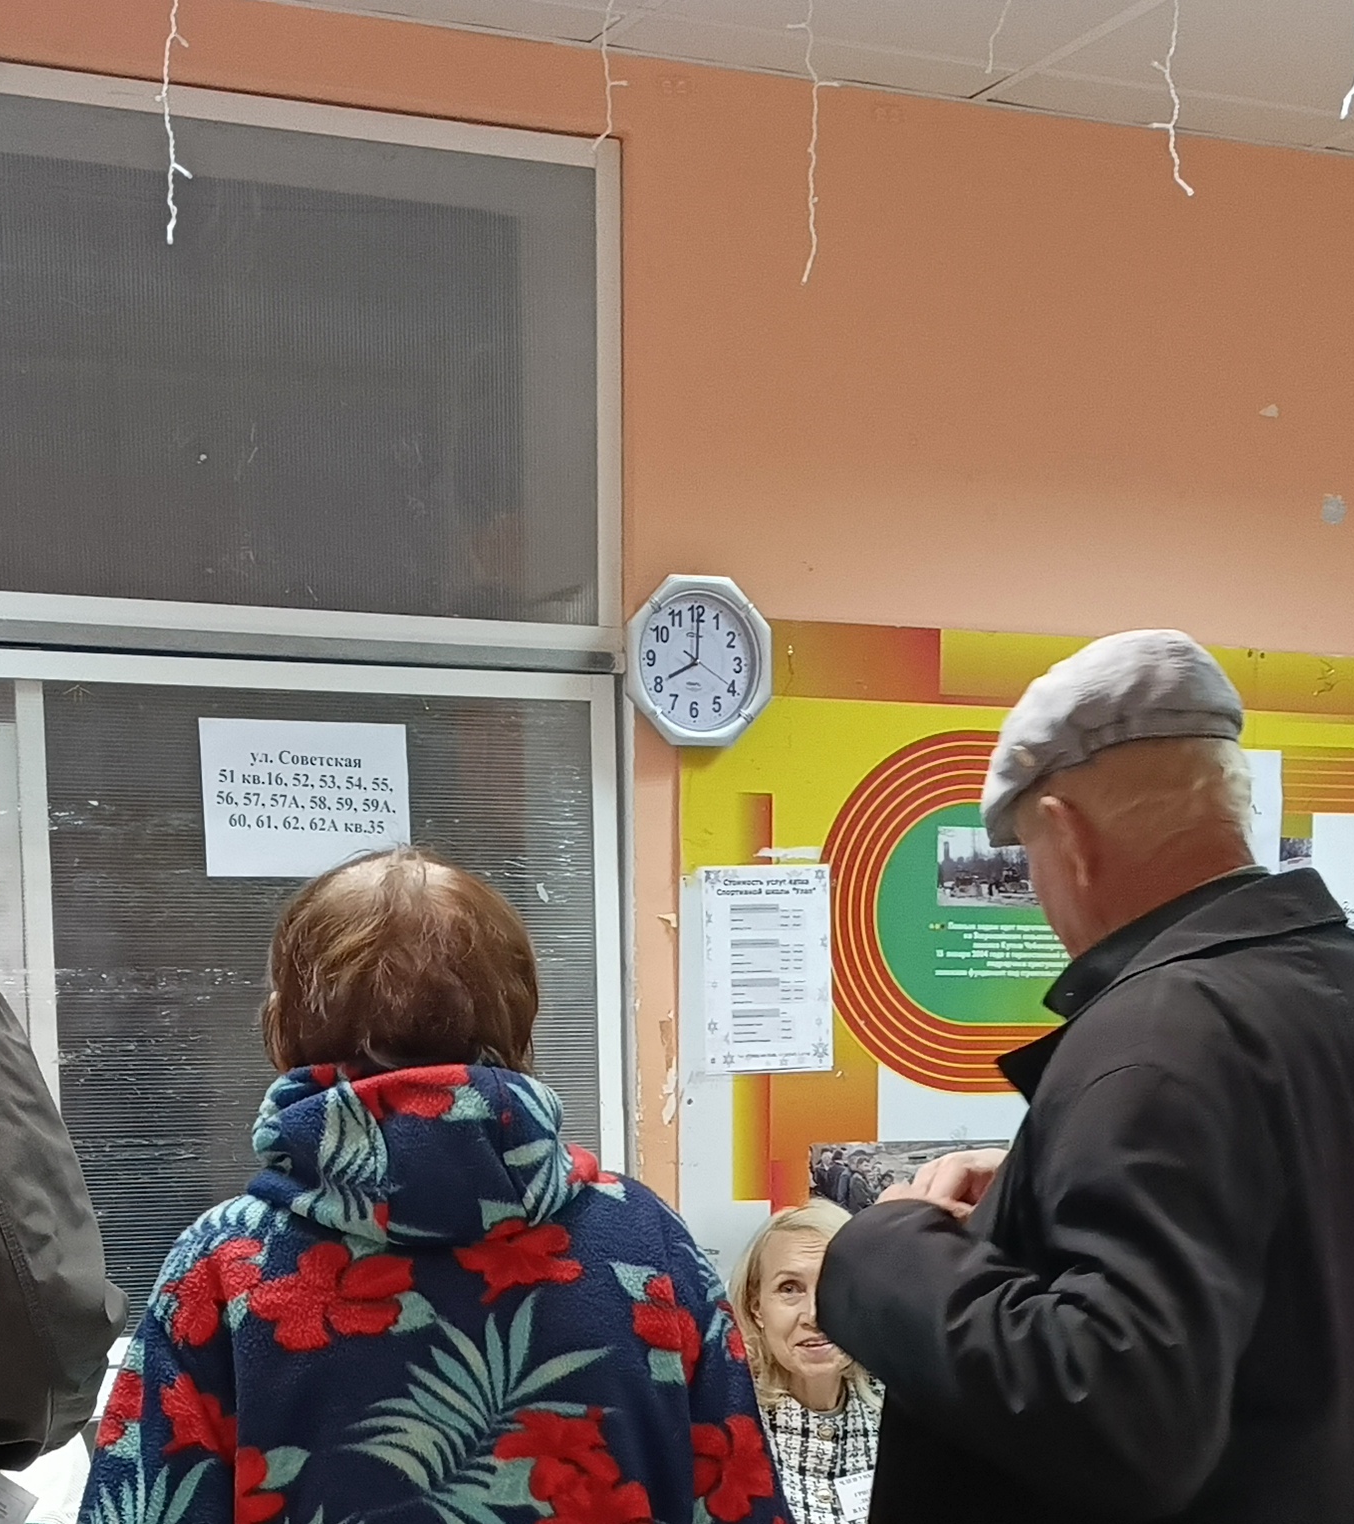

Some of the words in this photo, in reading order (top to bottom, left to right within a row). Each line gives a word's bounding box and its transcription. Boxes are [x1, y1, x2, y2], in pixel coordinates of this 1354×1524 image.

[668, 609, 682, 628] 11
[688, 605, 705, 623] 12
[713, 613, 720, 630] 1
[653, 625, 669, 643] 10
[726, 631, 736, 648] 2
[646, 649, 656, 667] 9
[733, 657, 743, 674] 3
[654, 676, 664, 693] 8
[727, 679, 736, 696] 4
[669, 694, 679, 711] 7
[689, 701, 699, 718] 6
[712, 696, 722, 713] 5
[250, 752, 273, 766] ул.
[279, 750, 362, 769] Советская
[218, 769, 235, 783] 51
[242, 772, 288, 787] кв.16,
[292, 773, 315, 789] 52,
[319, 775, 341, 790] 53,
[371, 778, 393, 793] 55,
[216, 791, 239, 807] 56,
[243, 793, 266, 808] 57,
[270, 794, 305, 810] 57А,
[309, 796, 332, 811] 58,
[335, 797, 358, 813] 59,
[228, 813, 252, 829] 60,
[256, 815, 278, 830] 61,
[282, 816, 305, 831] 62,
[309, 818, 338, 832] 62А
[344, 820, 385, 834] кв.35
